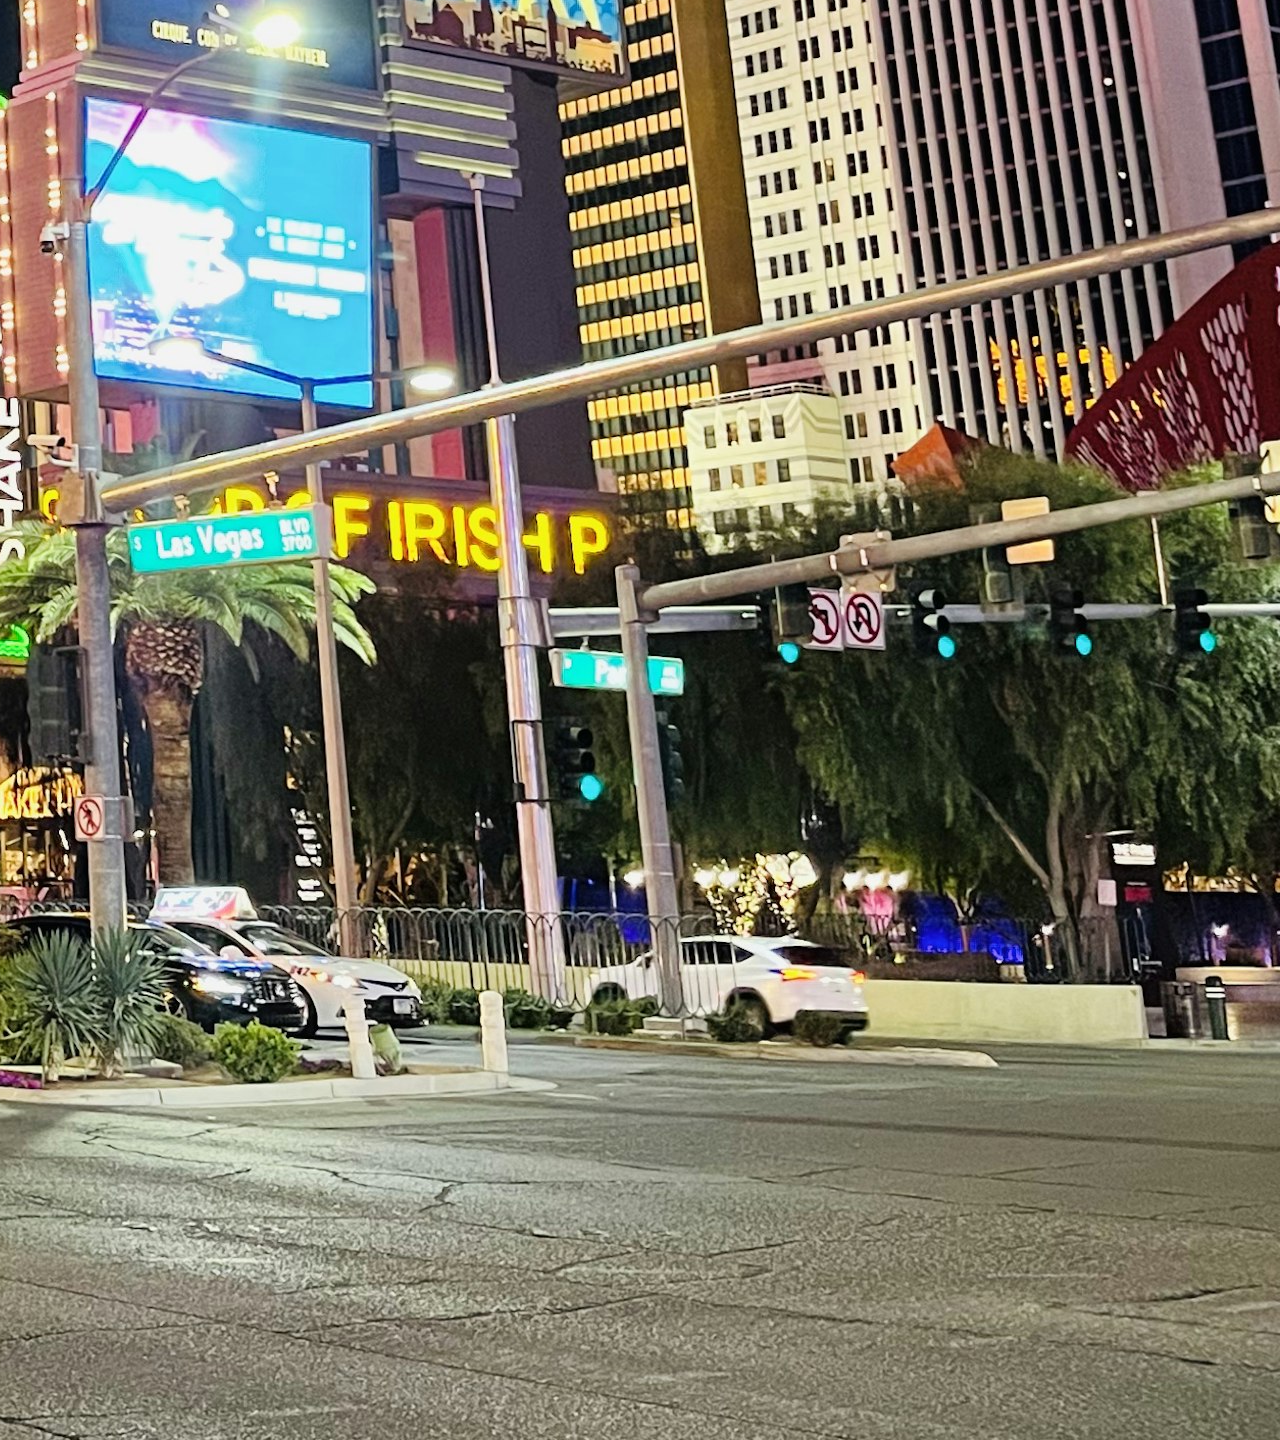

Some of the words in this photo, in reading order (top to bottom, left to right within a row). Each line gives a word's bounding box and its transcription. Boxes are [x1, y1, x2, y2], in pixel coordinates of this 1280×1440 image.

[278, 517, 310, 535] BLVD
[388, 500, 553, 574] IRISH
[133, 536, 142, 551] S
[156, 530, 195, 559] Las
[196, 525, 264, 559] Vegas
[282, 534, 312, 552] 3700
